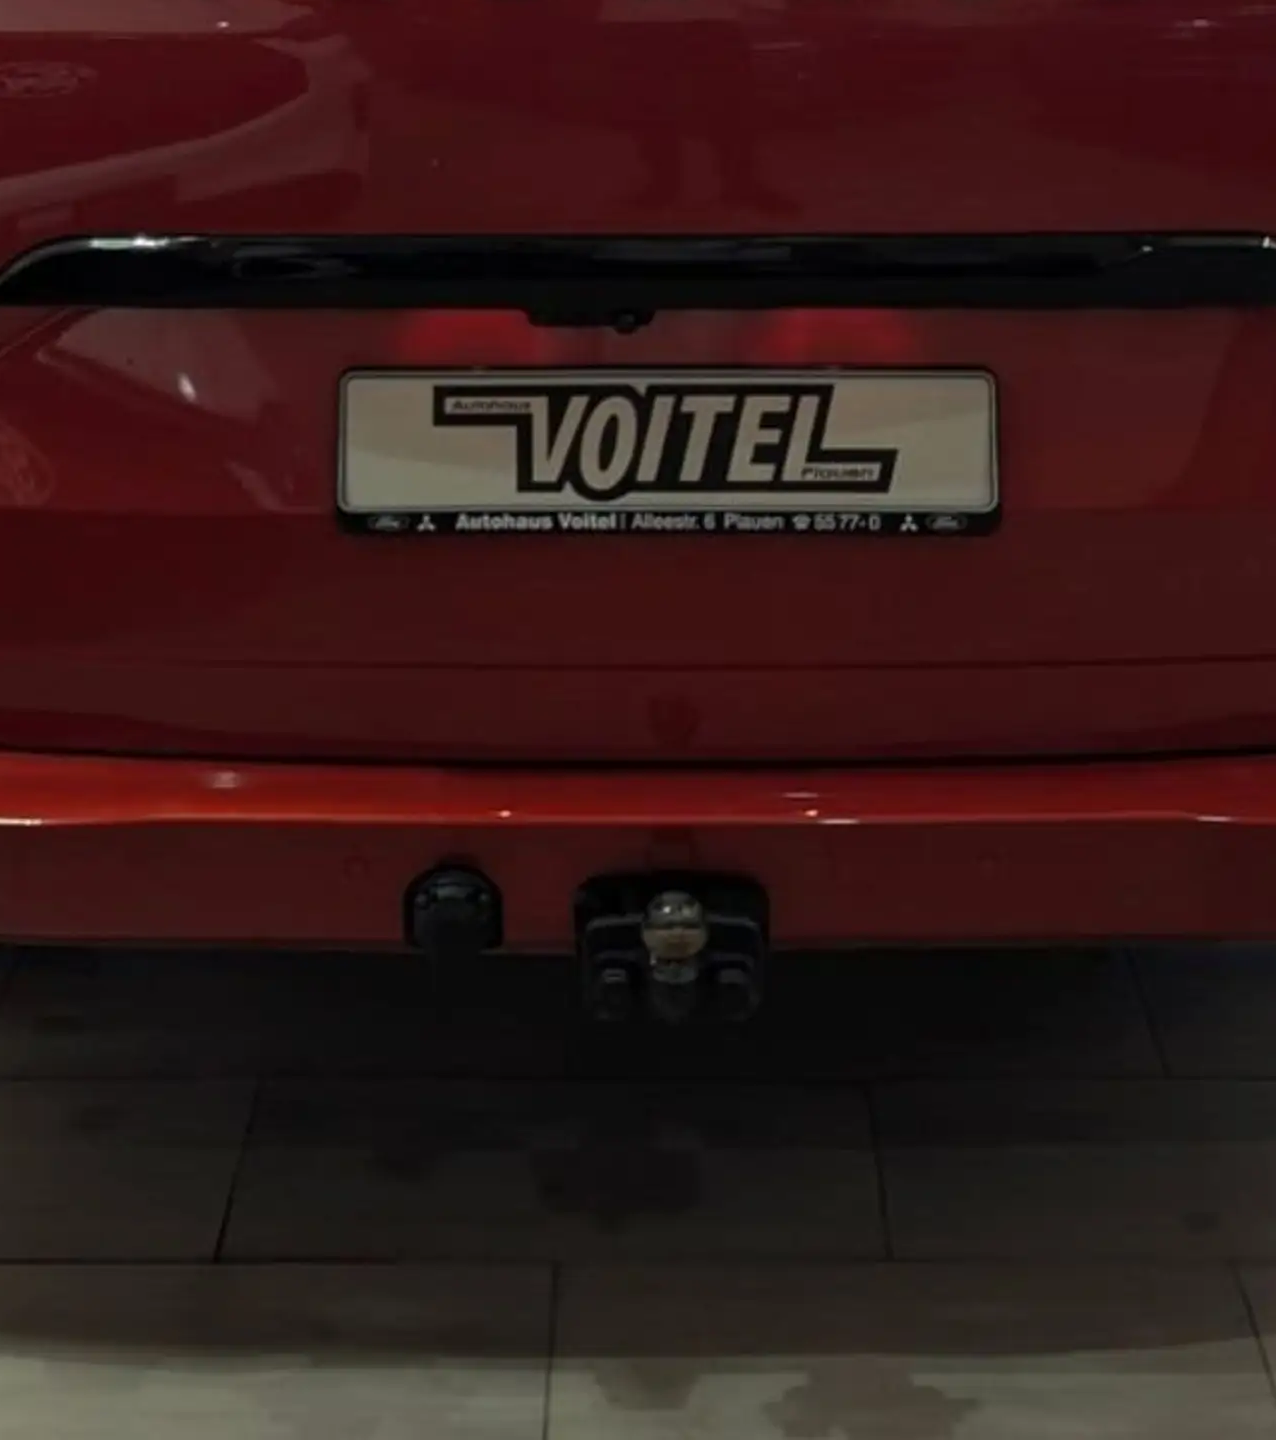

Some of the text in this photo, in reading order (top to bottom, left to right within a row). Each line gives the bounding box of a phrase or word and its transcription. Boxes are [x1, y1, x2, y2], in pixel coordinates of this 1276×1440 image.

[531, 395, 821, 491] VOITEL
[455, 513, 553, 529] Autohaus
[558, 512, 616, 529] Voitel
[724, 513, 784, 530] Plauen
